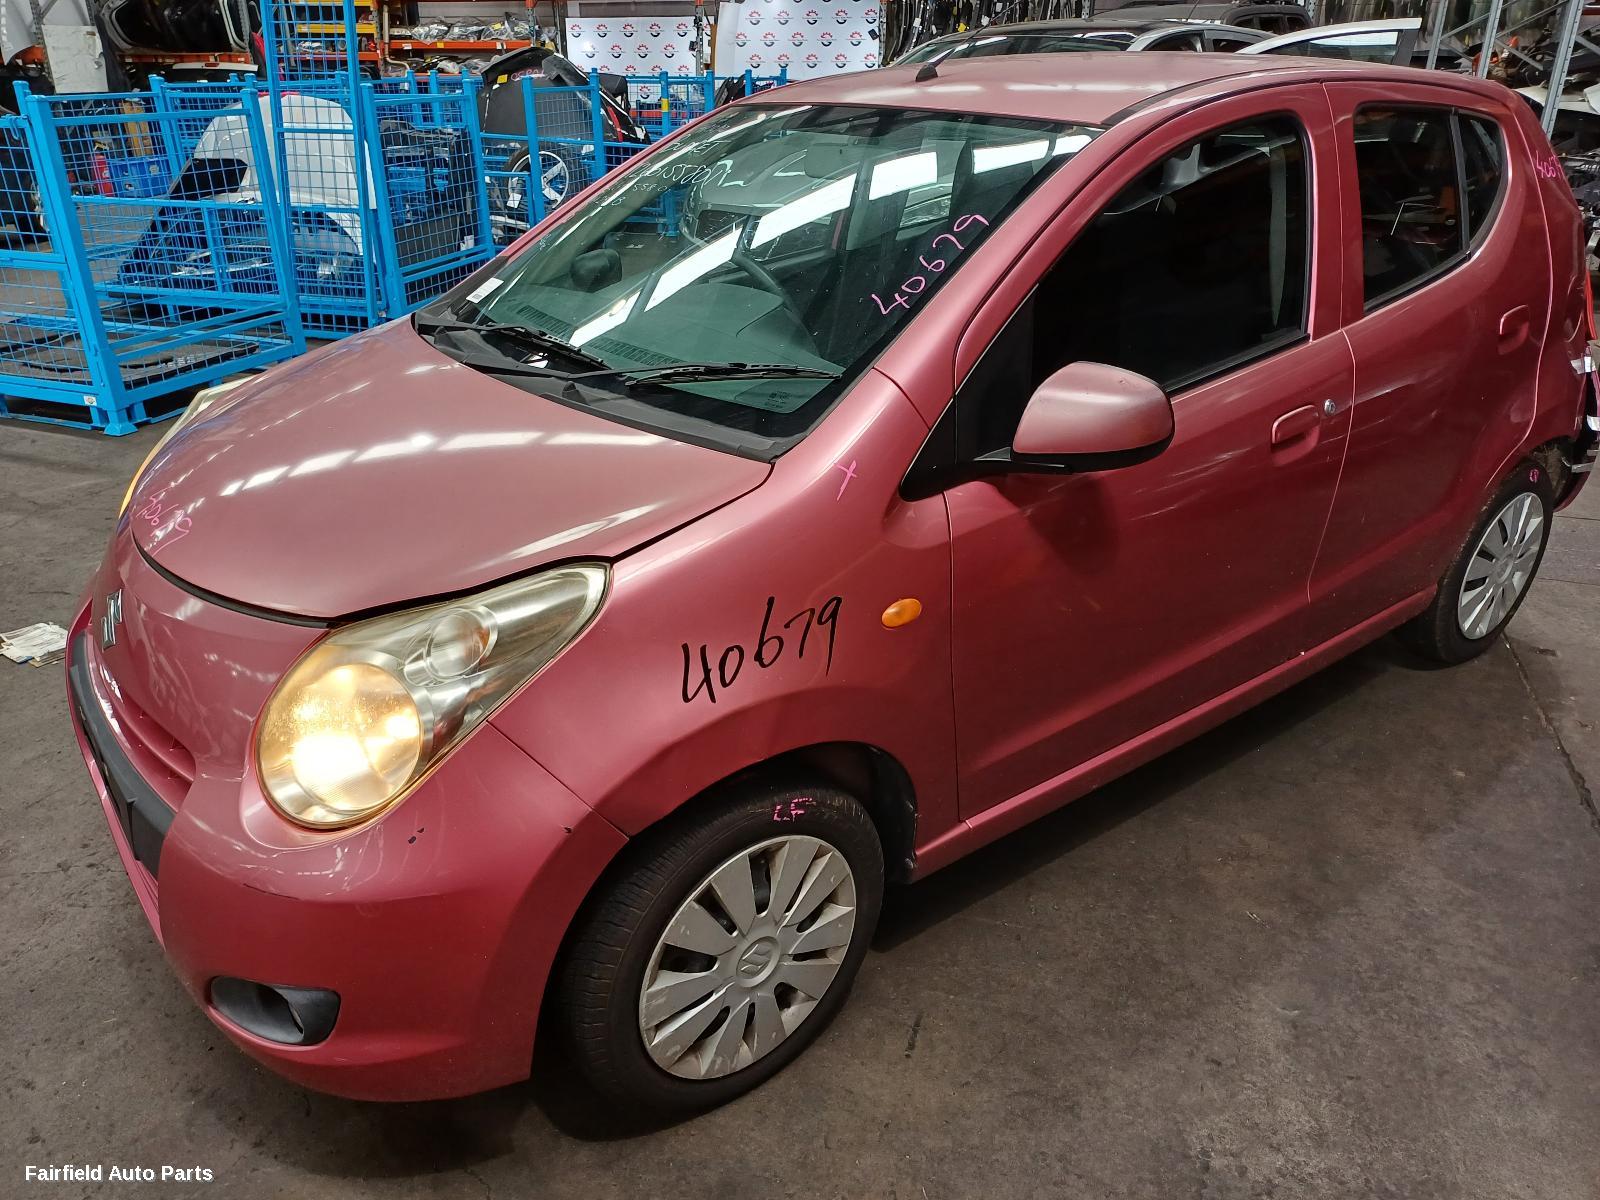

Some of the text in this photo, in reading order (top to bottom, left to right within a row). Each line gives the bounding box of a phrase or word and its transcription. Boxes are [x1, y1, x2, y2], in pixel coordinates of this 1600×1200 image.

[871, 214, 990, 315] 40679
[680, 595, 843, 705] 40679
[772, 796, 816, 823] LF
